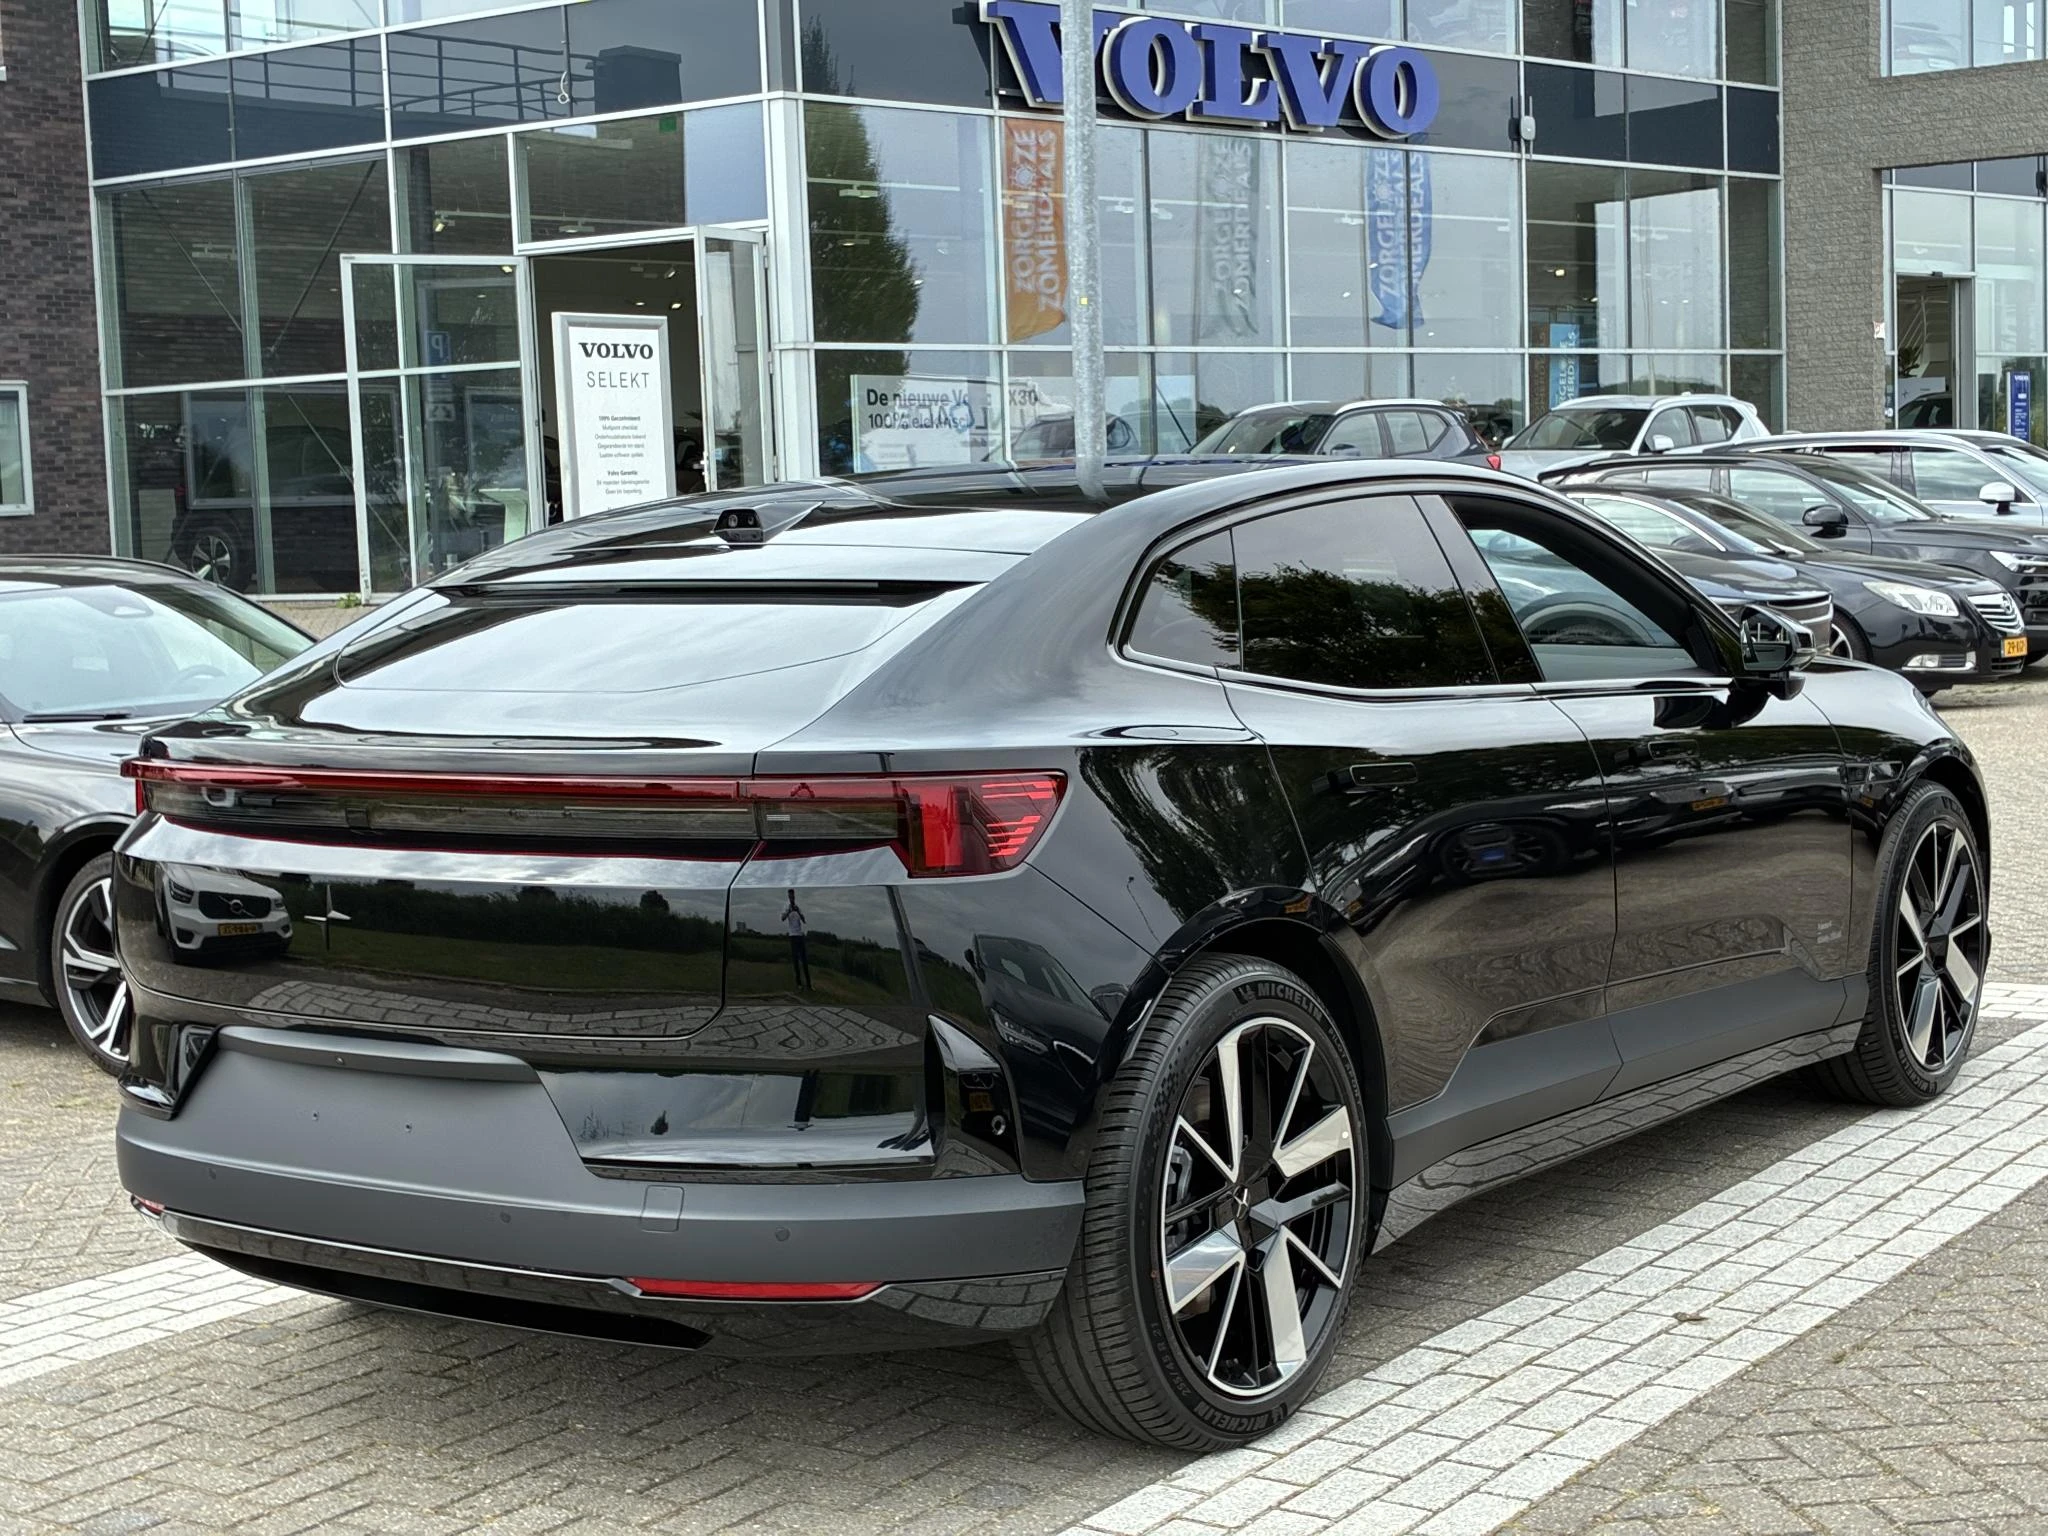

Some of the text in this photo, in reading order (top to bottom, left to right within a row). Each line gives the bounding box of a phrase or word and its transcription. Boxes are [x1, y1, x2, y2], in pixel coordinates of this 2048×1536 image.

[979, 0, 1439, 138] VOLVO
[578, 342, 654, 360] VOLVO
[586, 370, 650, 388] SELEKT
[867, 388, 889, 406] De
[893, 390, 950, 406] nieuwe
[1257, 982, 1323, 1020] MICHELIN
[1194, 1401, 1269, 1432] MICHELIN
